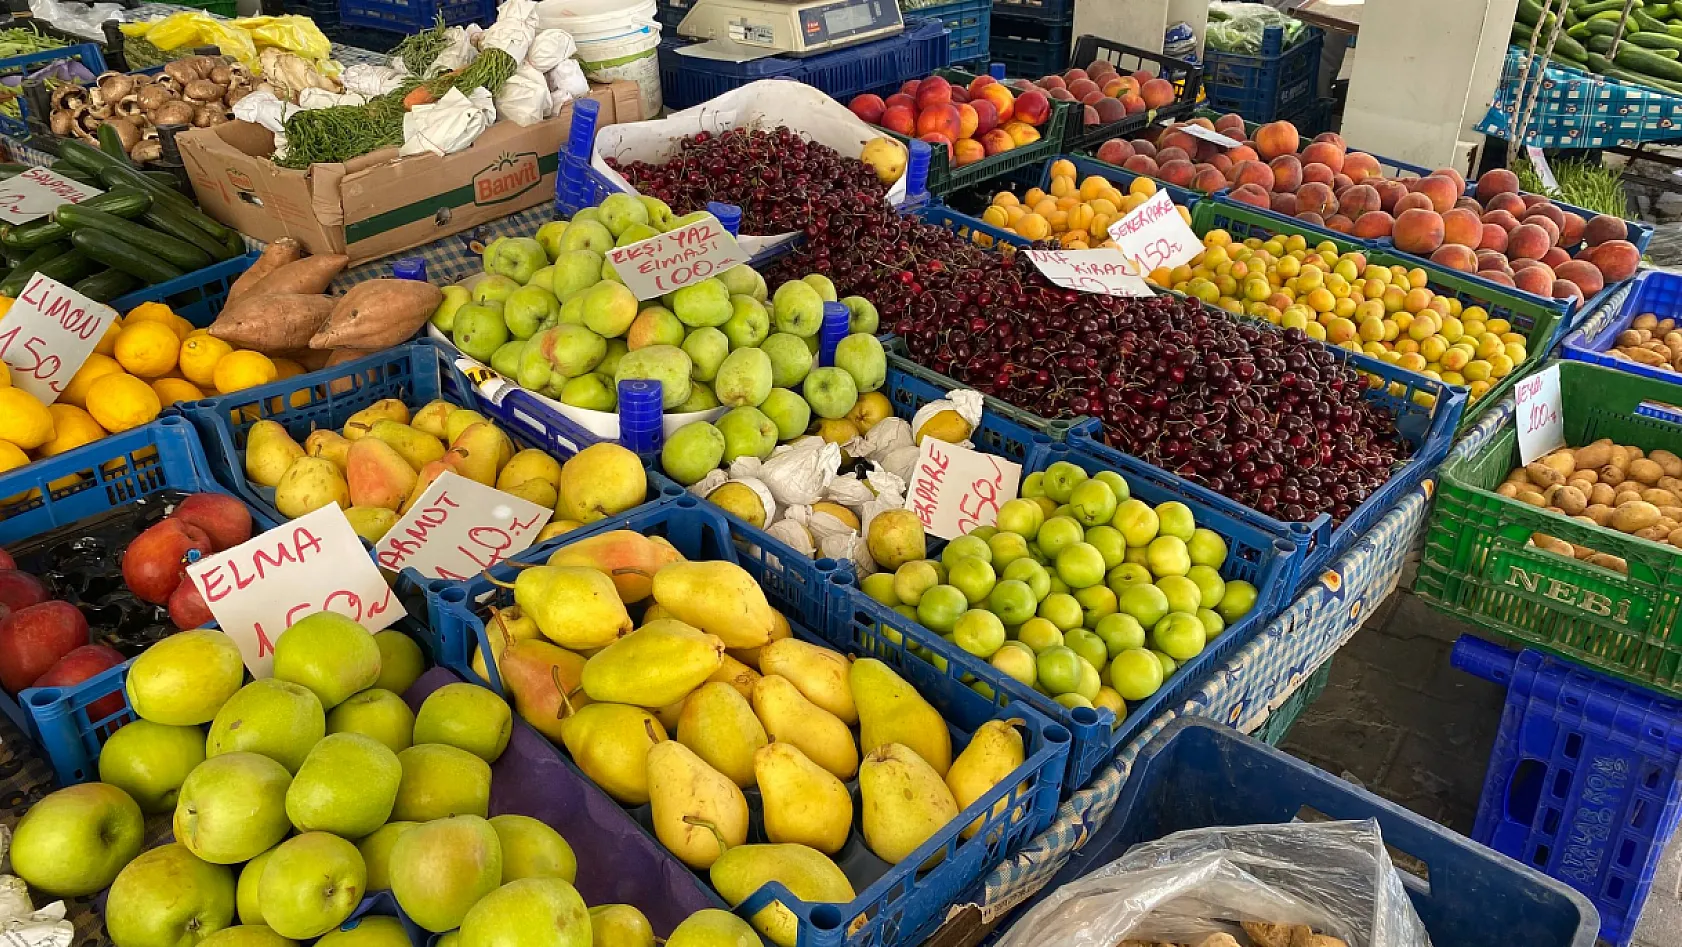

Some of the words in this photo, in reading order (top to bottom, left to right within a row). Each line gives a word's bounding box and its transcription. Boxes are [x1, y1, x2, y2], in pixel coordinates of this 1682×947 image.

[477, 162, 537, 201] Banvit
[668, 225, 721, 248] YAZ
[376, 490, 460, 571] ARMUT
[200, 526, 323, 603] ELMA
